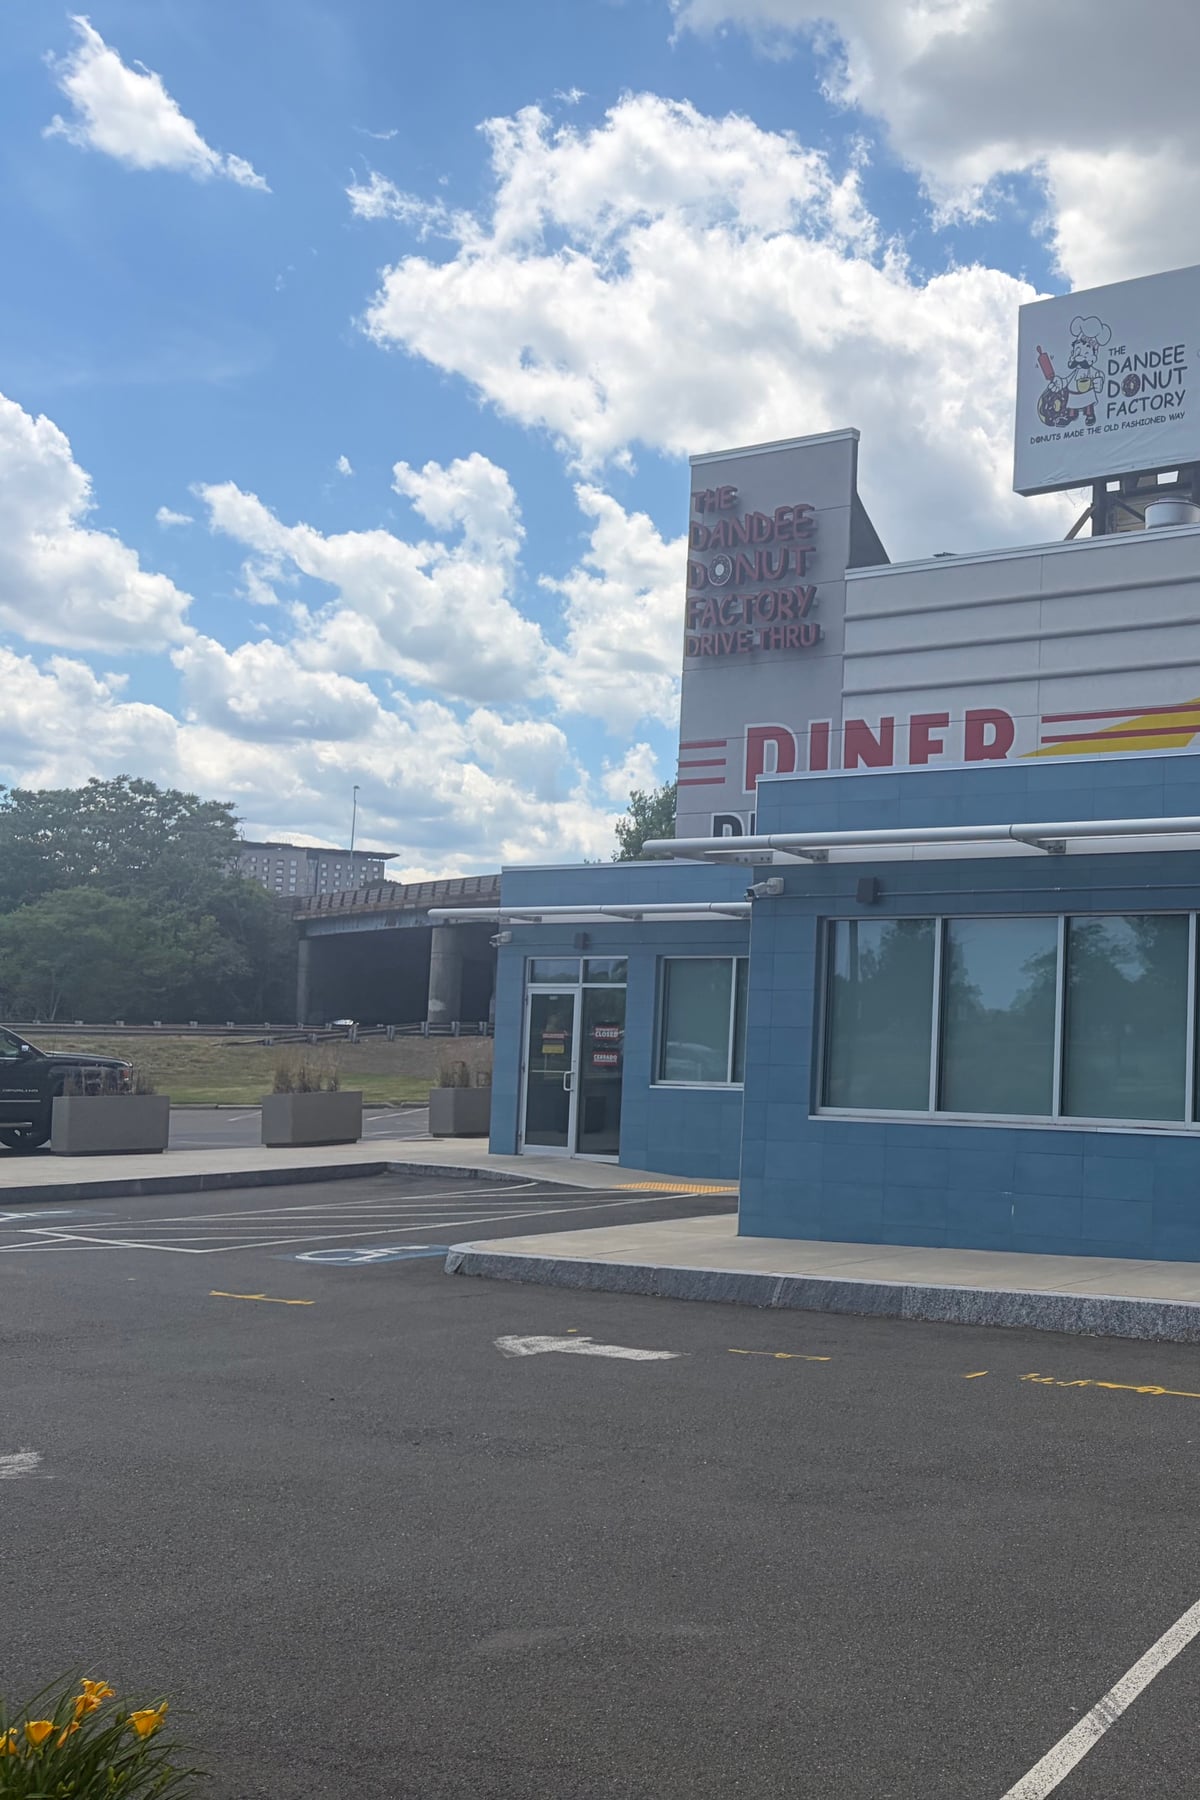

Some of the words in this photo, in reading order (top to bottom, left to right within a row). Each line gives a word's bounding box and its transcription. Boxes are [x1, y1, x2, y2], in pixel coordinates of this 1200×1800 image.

[1107, 344, 1186, 376] DANDEE
[1108, 345, 1126, 356] THE
[1107, 366, 1188, 398] DONUT
[1106, 389, 1186, 419] FACTORY
[1030, 432, 1061, 445] DONUTS
[1063, 428, 1084, 442] MADE
[1087, 425, 1102, 435] THE
[1104, 421, 1119, 433] OLD
[1121, 415, 1166, 430] FASHIONED
[1169, 411, 1186, 421] WAY
[691, 485, 738, 513] THE
[689, 503, 816, 552] DANDEE
[686, 545, 817, 590] DONUT
[686, 585, 818, 630] FACTORY
[685, 629, 754, 658] DRIVE
[755, 623, 821, 650] THRU
